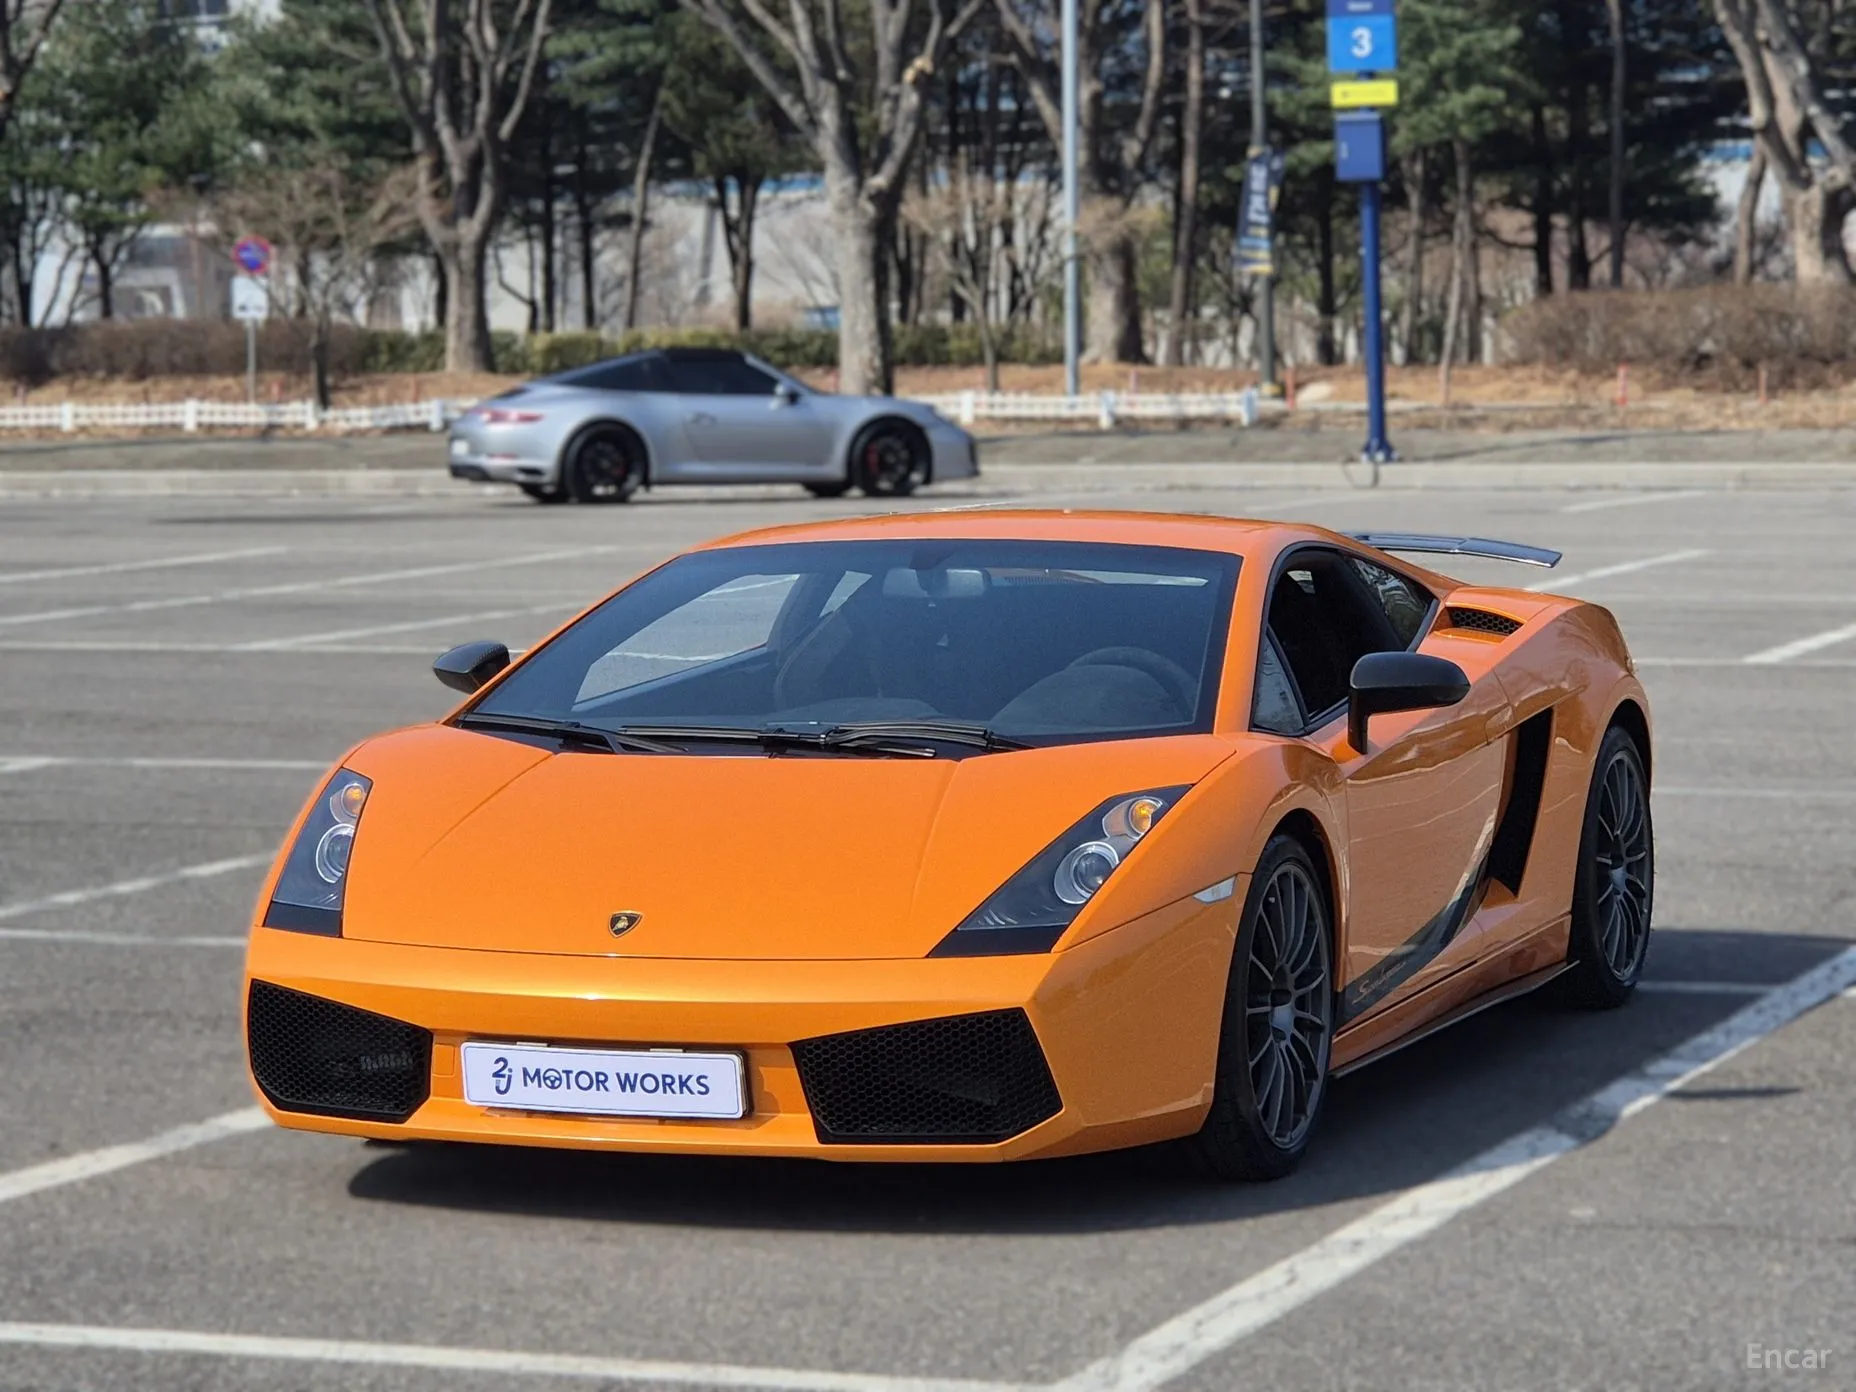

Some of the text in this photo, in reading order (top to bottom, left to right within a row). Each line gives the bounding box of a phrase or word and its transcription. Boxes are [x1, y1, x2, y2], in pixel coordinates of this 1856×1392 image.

[1351, 26, 1373, 58] 3
[522, 1067, 609, 1093] MOTOR
[616, 1071, 710, 1096] WORKS
